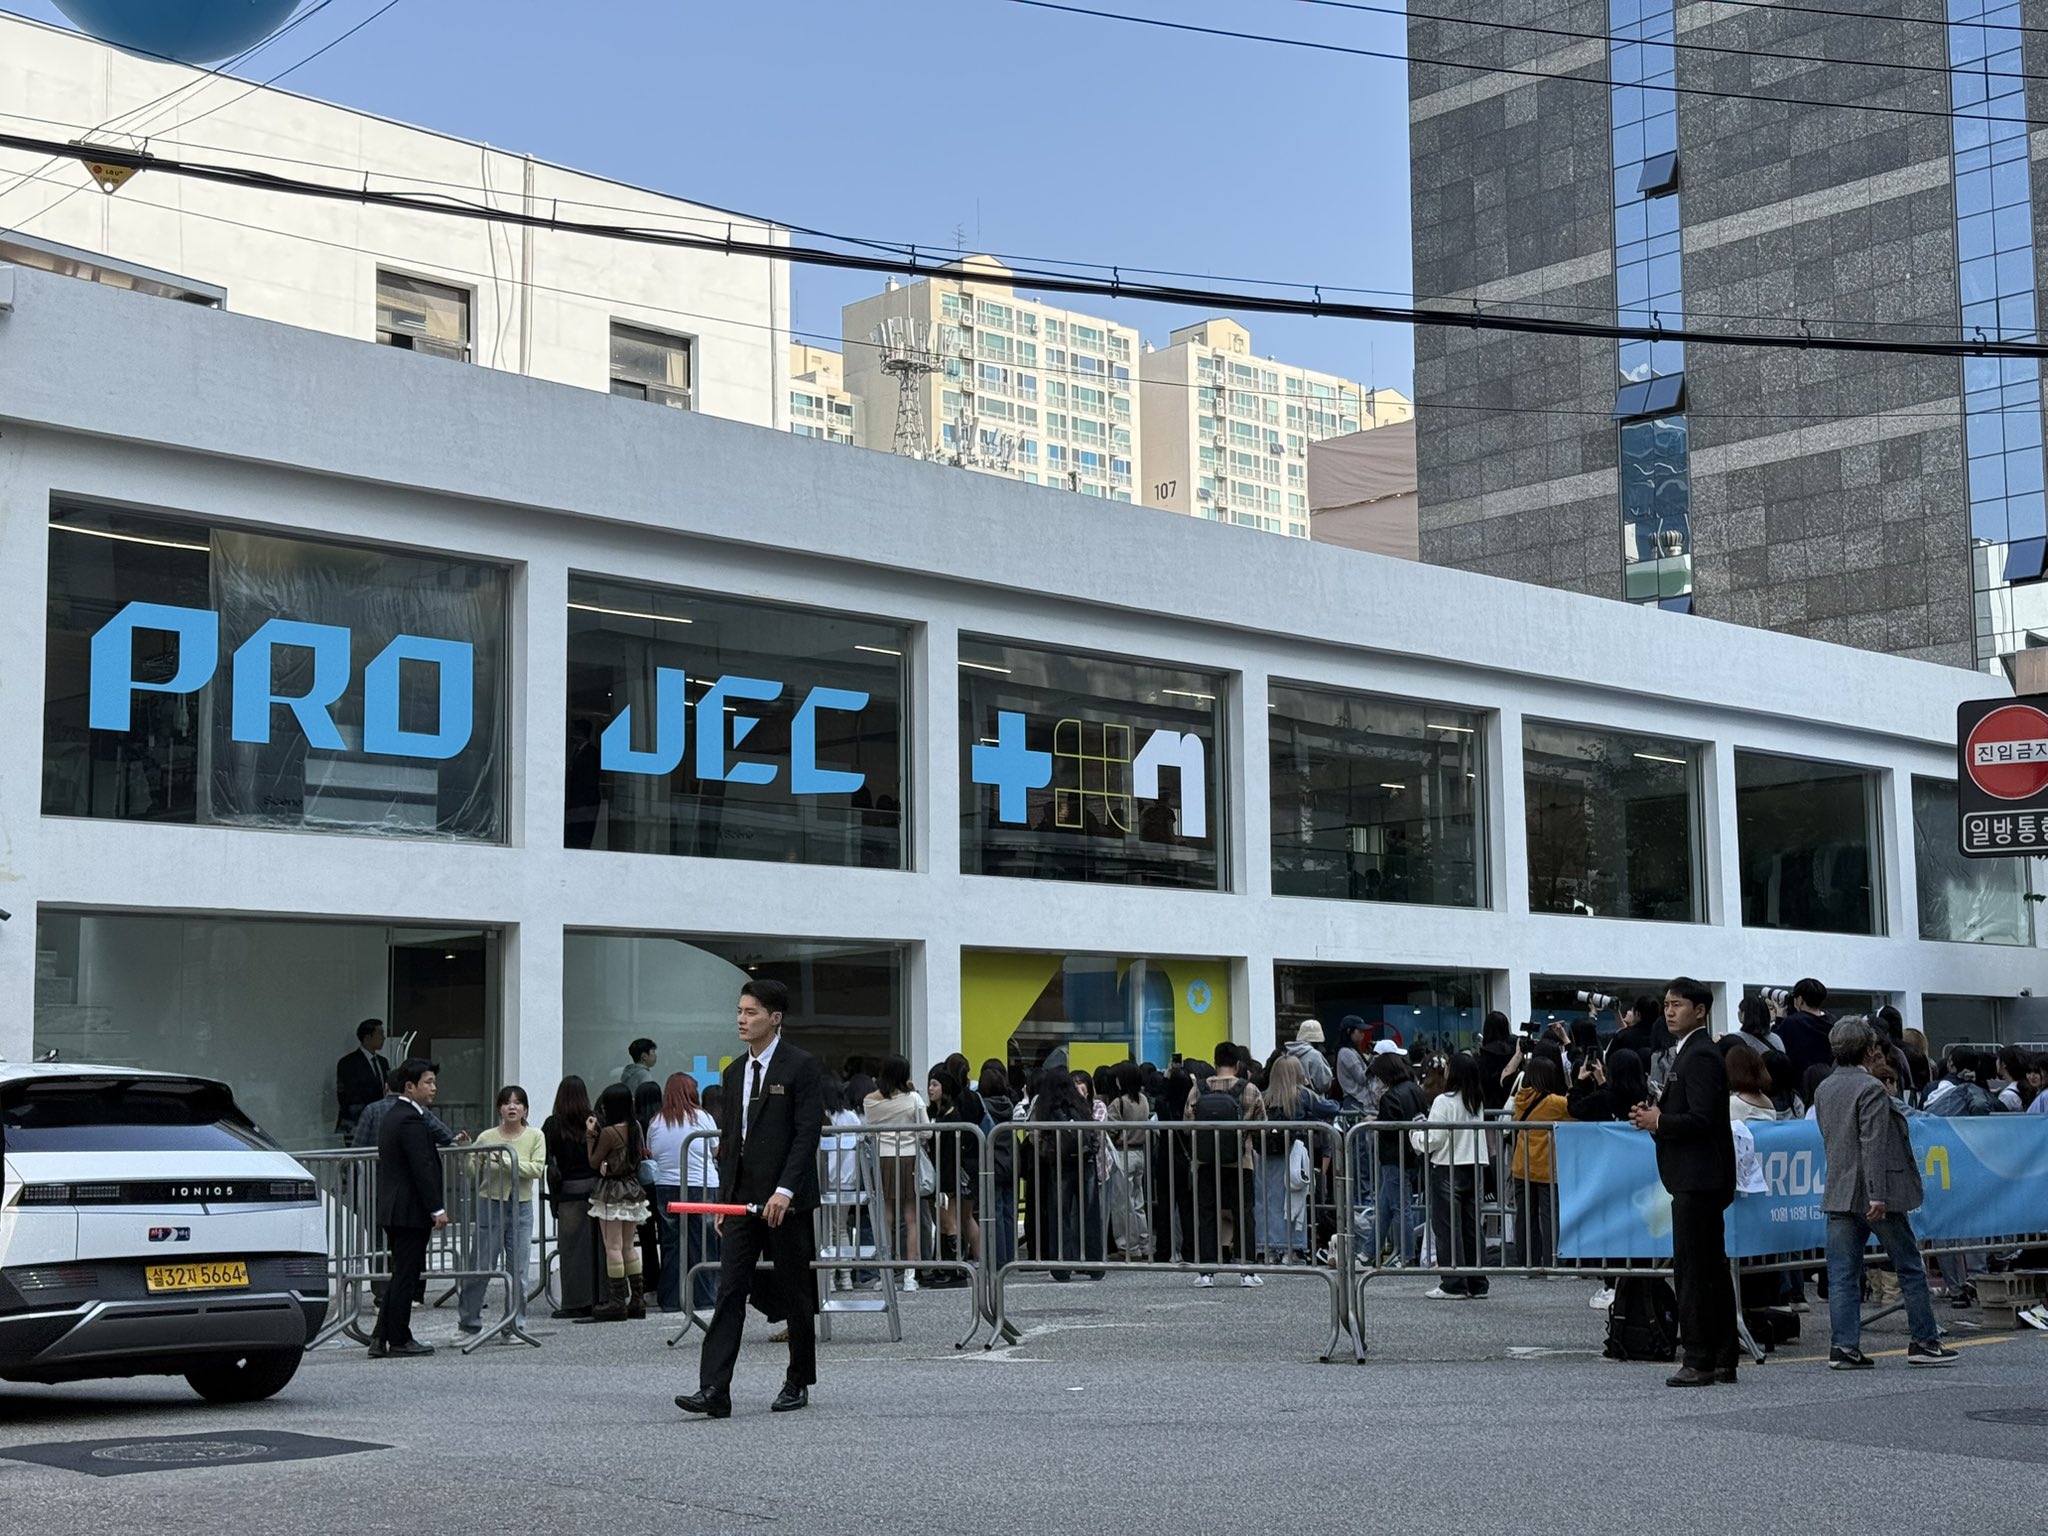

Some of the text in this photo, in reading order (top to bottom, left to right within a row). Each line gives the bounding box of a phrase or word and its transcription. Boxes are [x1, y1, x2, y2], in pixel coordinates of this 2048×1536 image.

[1154, 480, 1177, 500] 107
[1770, 1204, 1824, 1222] 10월 18일 (금
[201, 1265, 243, 1284] 5664
